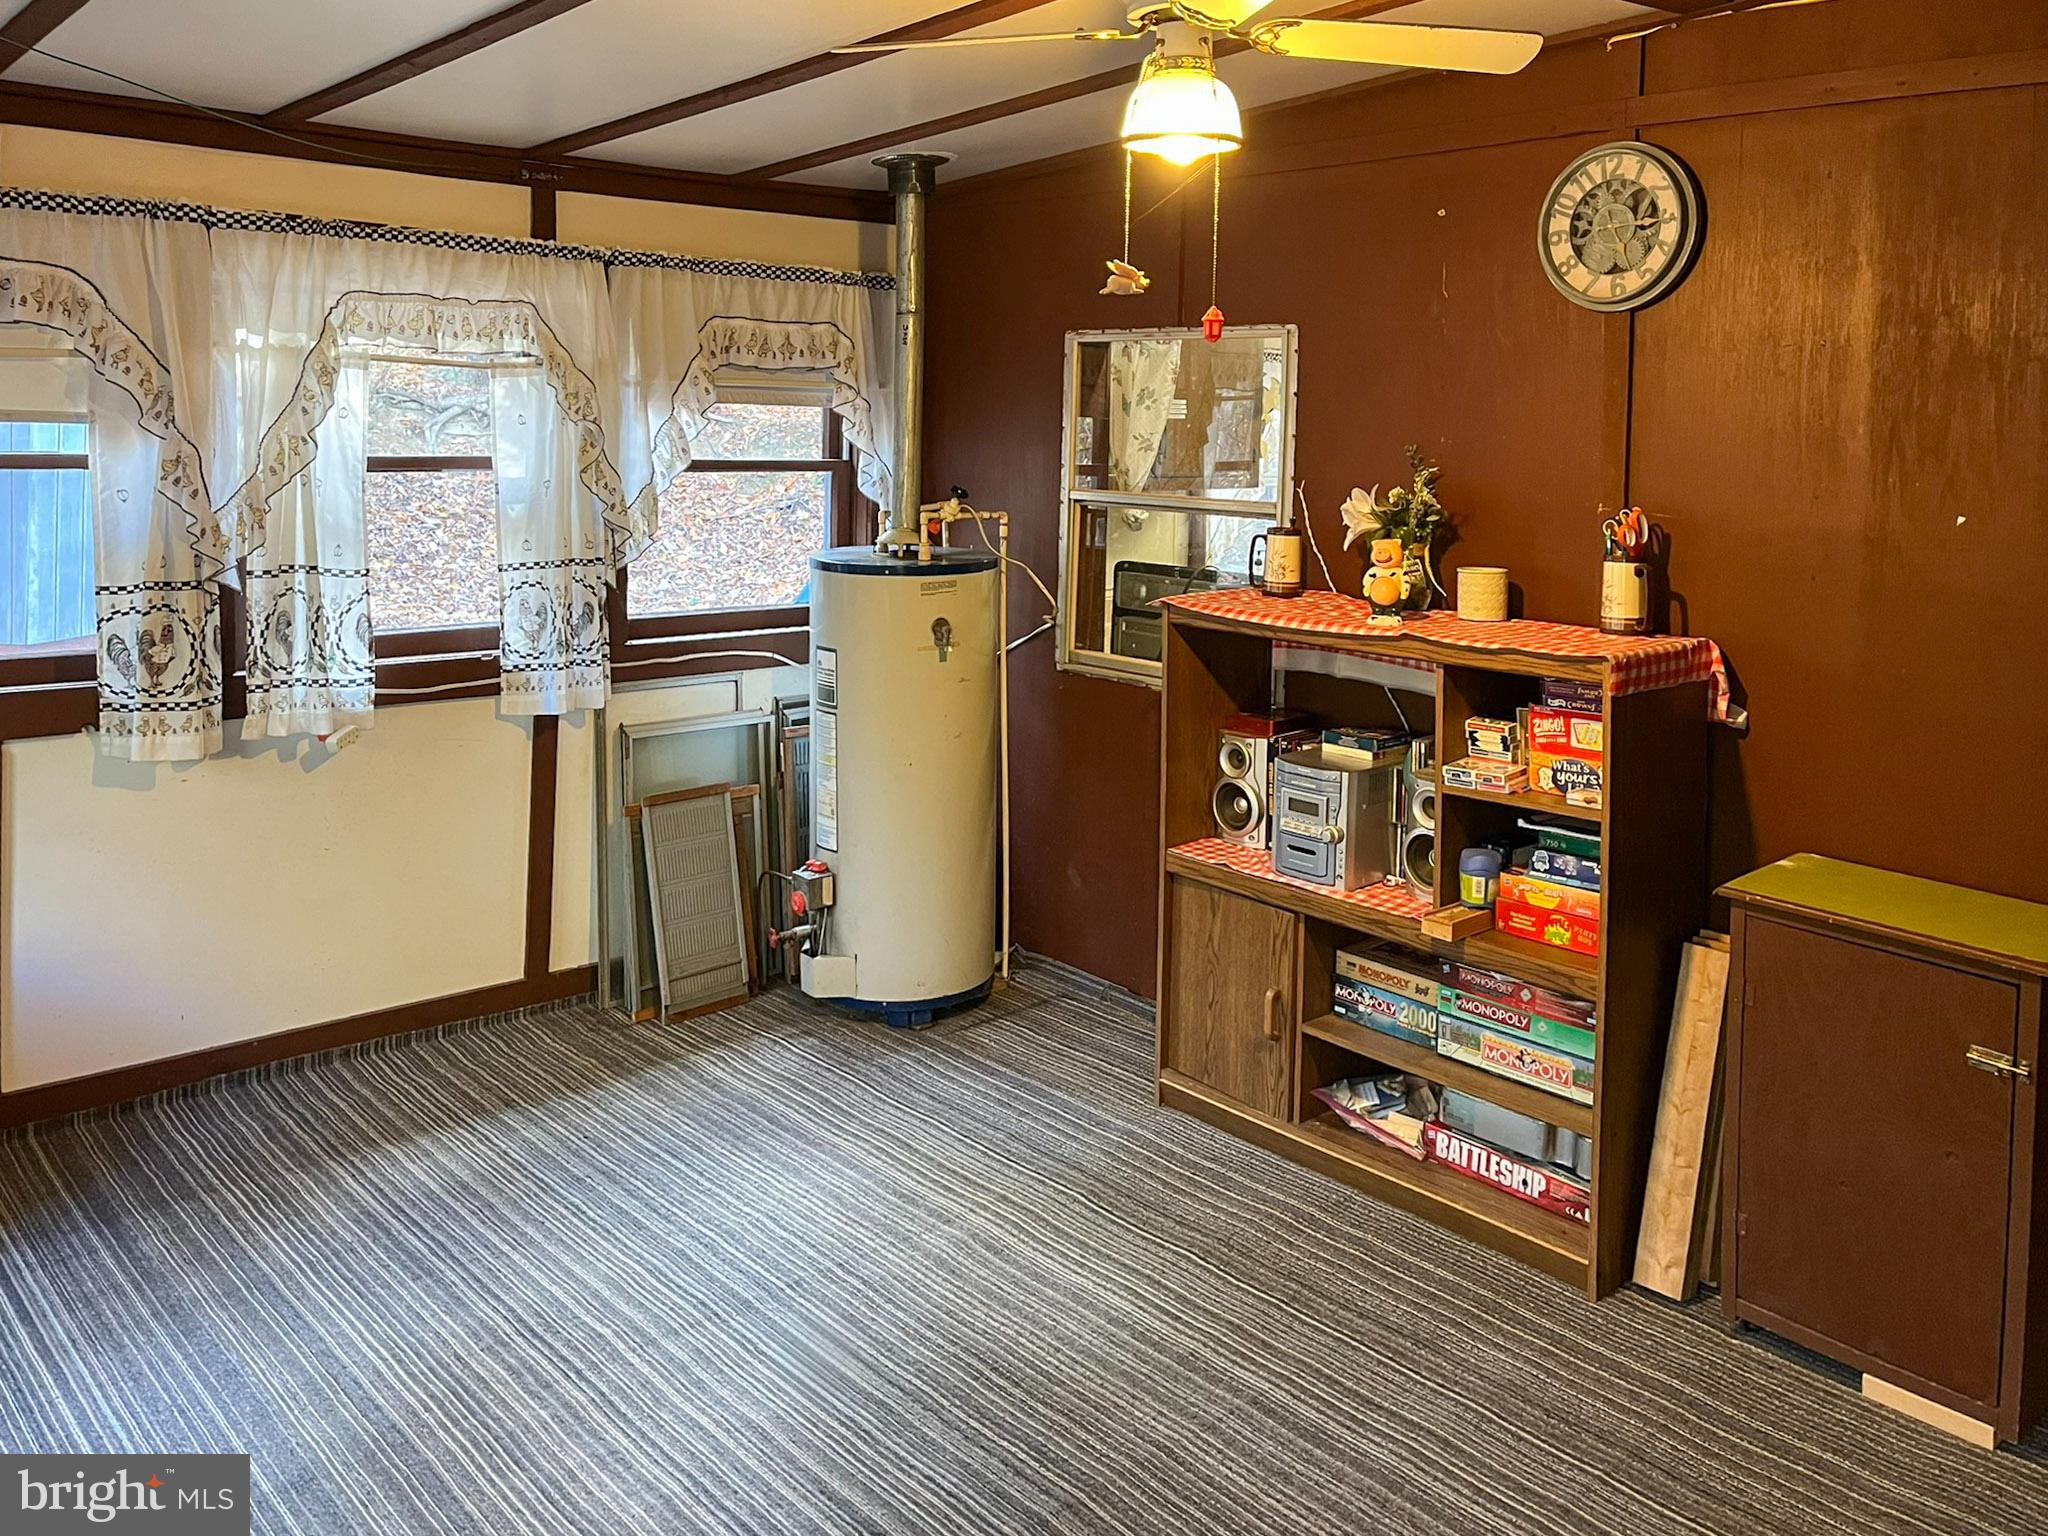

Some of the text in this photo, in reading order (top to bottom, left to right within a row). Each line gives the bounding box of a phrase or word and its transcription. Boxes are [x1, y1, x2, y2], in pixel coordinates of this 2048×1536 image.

[1596, 154, 1625, 180] 12
[1635, 157, 1649, 181] 1
[1571, 167, 1598, 196] 11
[1551, 193, 1578, 220] 10
[1549, 229, 1570, 247] 9
[1557, 254, 1580, 277] 8
[1610, 274, 1626, 298] 6
[1532, 715, 1566, 735] ZINGO!
[1552, 759, 1590, 774] What's
[1557, 771, 1599, 786] yours
[1359, 963, 1412, 989] MONOPOLY
[1460, 970, 1516, 996] MONOPOLY
[1335, 983, 1398, 1016] MONOPOLY
[1399, 1001, 1437, 1034] 2000
[1460, 997, 1530, 1029] MONOPOLY
[1483, 1043, 1569, 1084] MONOPOLY
[1435, 1130, 1548, 1200] BATTLESHIP
